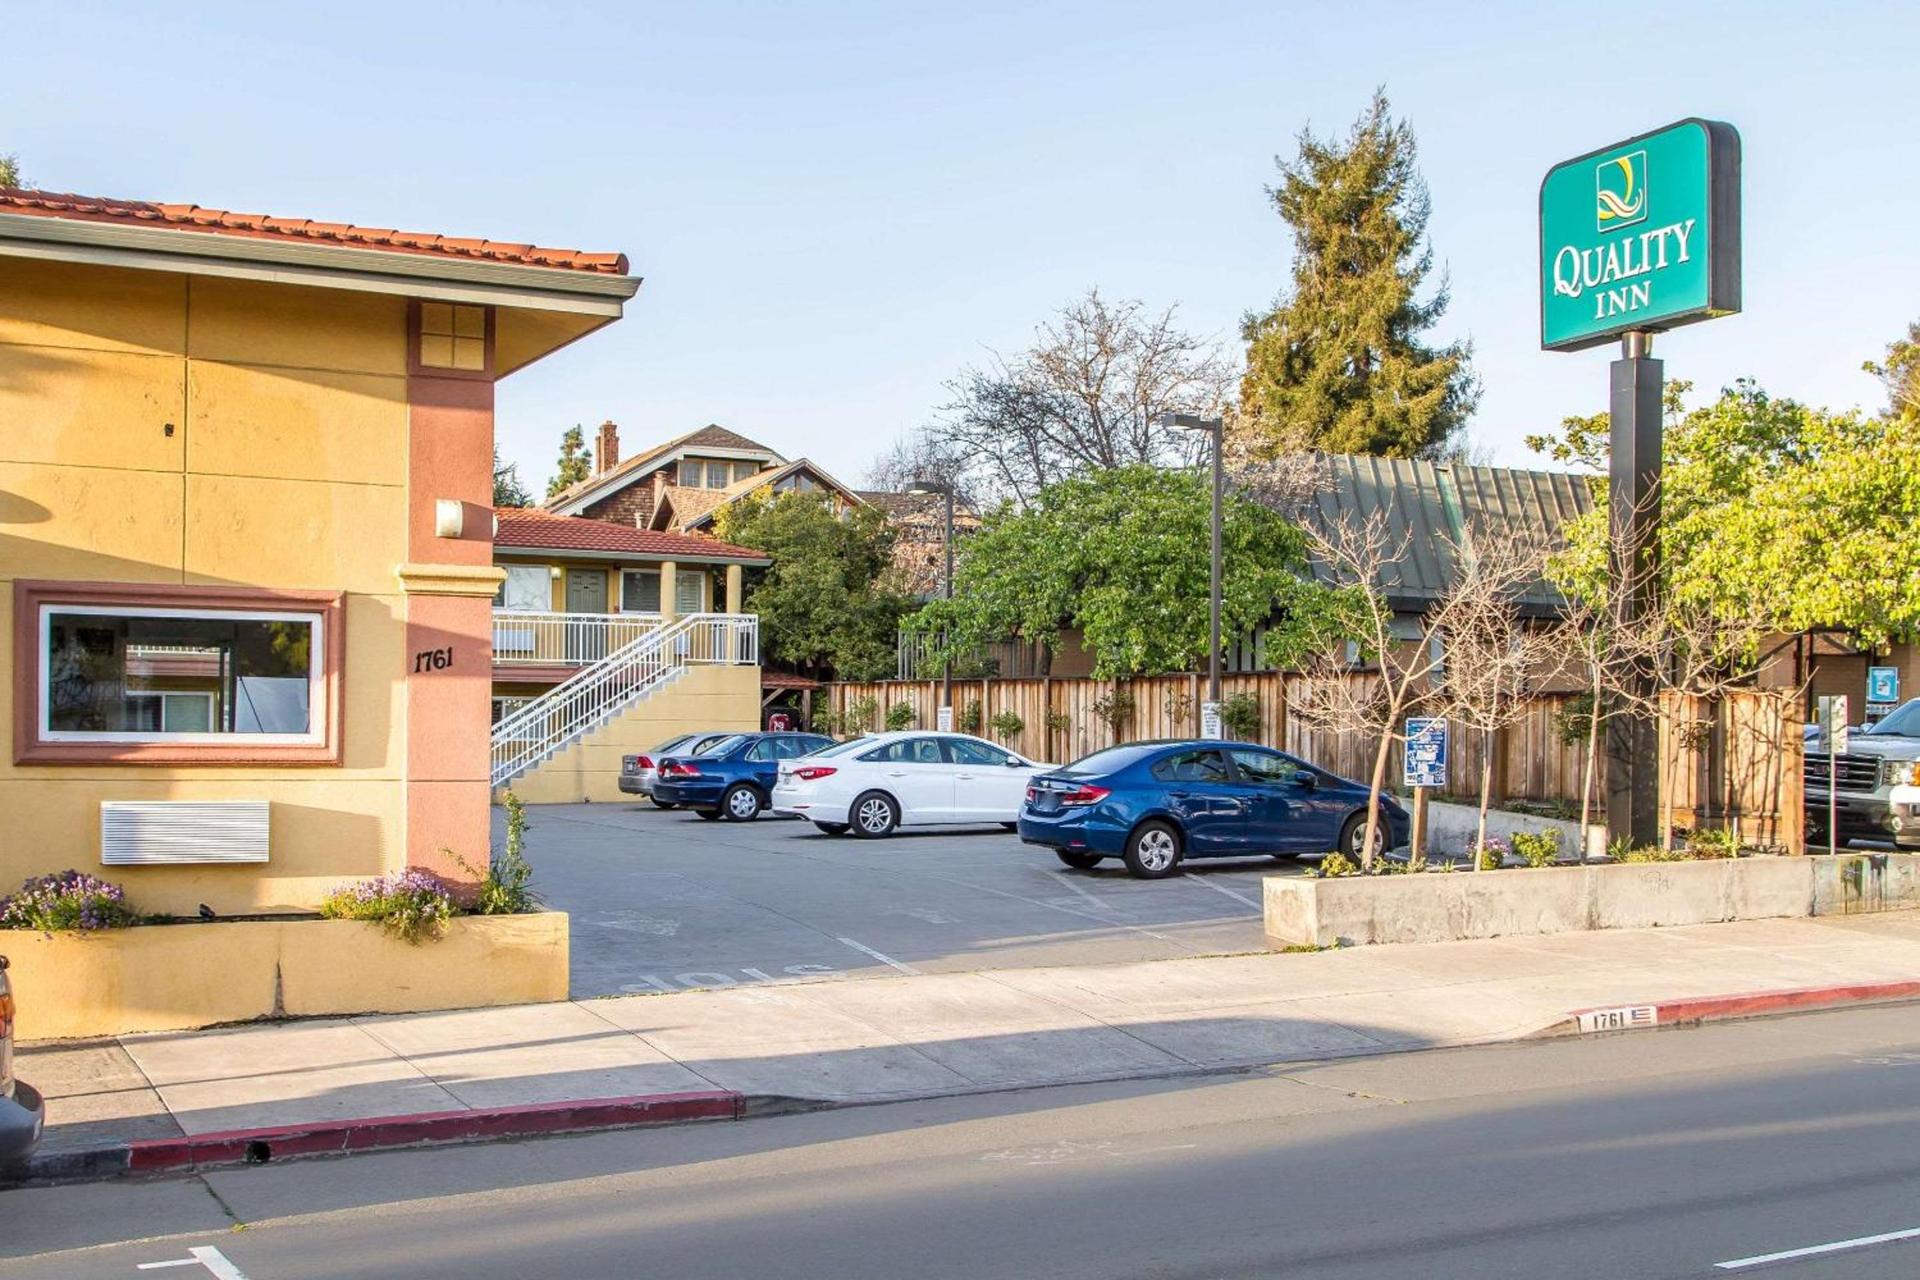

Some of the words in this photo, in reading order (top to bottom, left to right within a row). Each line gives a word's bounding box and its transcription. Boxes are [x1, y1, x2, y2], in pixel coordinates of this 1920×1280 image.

[1554, 219, 1696, 298] QUALITY
[1595, 280, 1652, 320] INN
[414, 646, 453, 674] 1761
[1593, 1011, 1625, 1030] 1761
